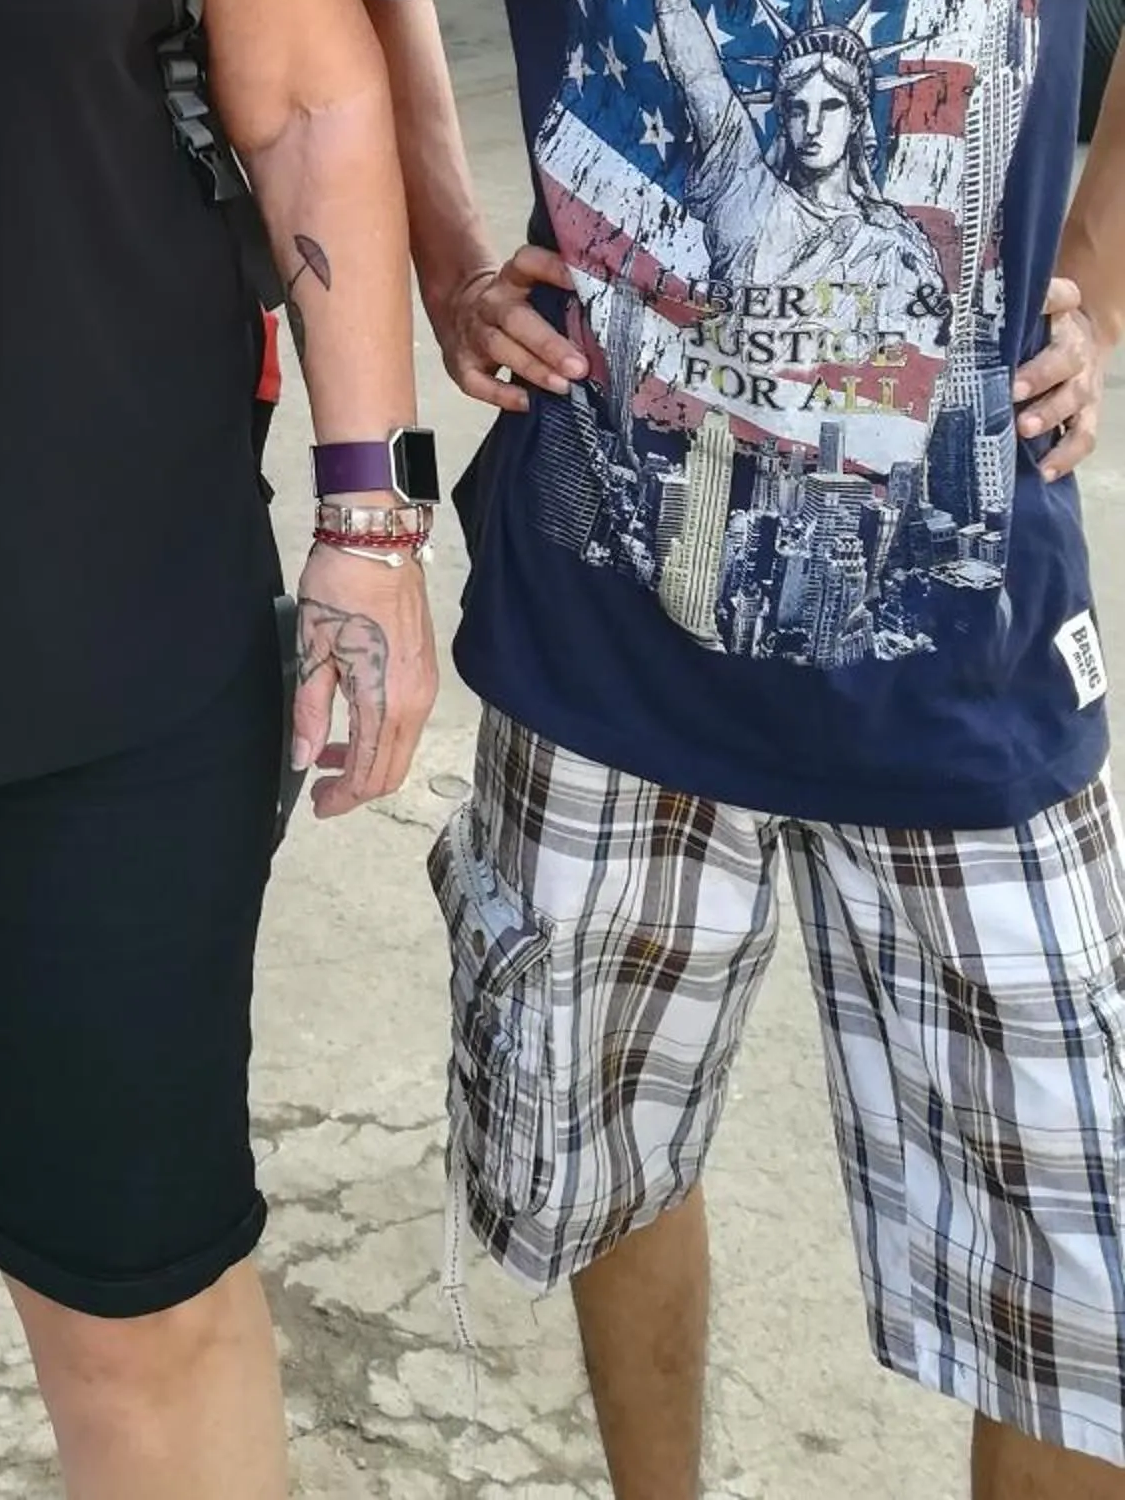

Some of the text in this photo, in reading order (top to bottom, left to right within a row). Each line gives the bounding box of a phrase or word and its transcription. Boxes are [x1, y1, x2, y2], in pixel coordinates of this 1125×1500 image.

[906, 282, 953, 319] &
[684, 356, 786, 412] FOR
[799, 374, 914, 416] ALL
[1071, 624, 1102, 690] BASIC
